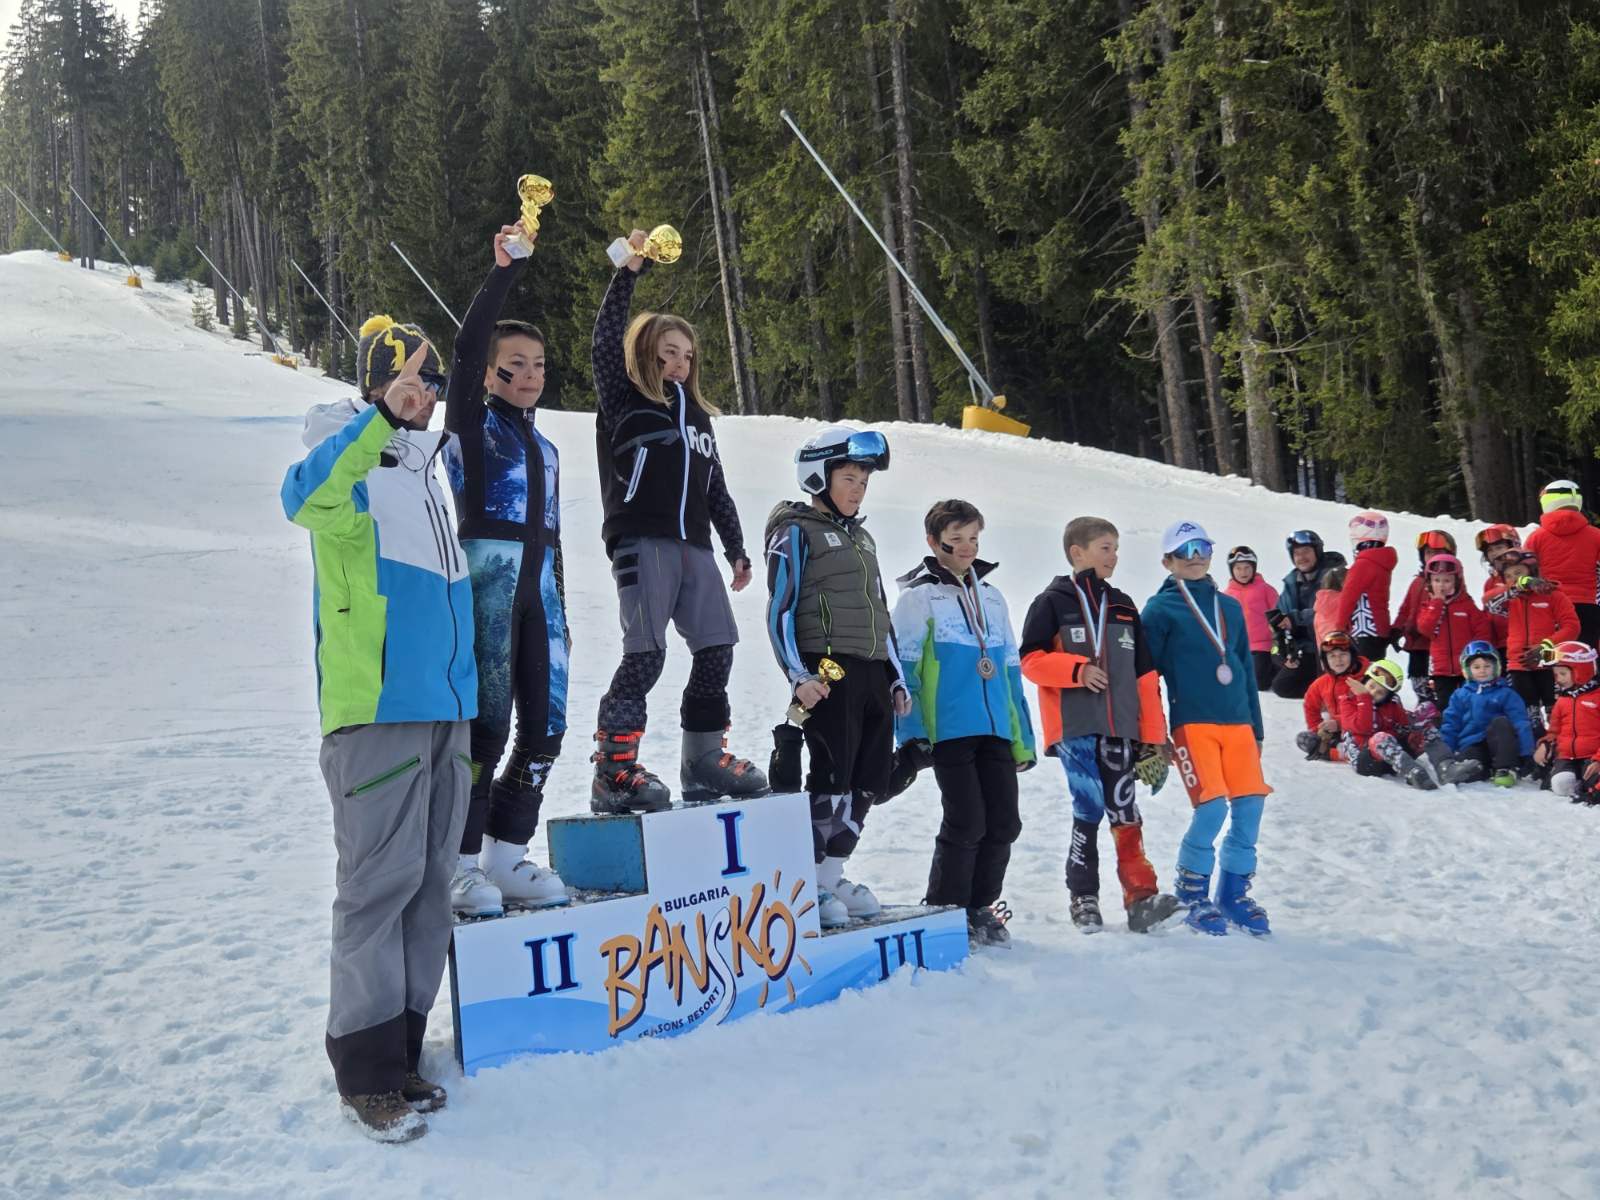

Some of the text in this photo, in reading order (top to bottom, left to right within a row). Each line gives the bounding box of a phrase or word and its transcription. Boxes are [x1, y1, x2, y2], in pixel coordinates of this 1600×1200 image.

[803, 449, 834, 459] HEAD
[716, 810, 748, 876] I
[664, 885, 731, 913] BULGARIA
[524, 932, 580, 998] II
[599, 881, 797, 1040] BANSKO
[873, 928, 929, 982] III
[687, 986, 721, 1024] RESORT
